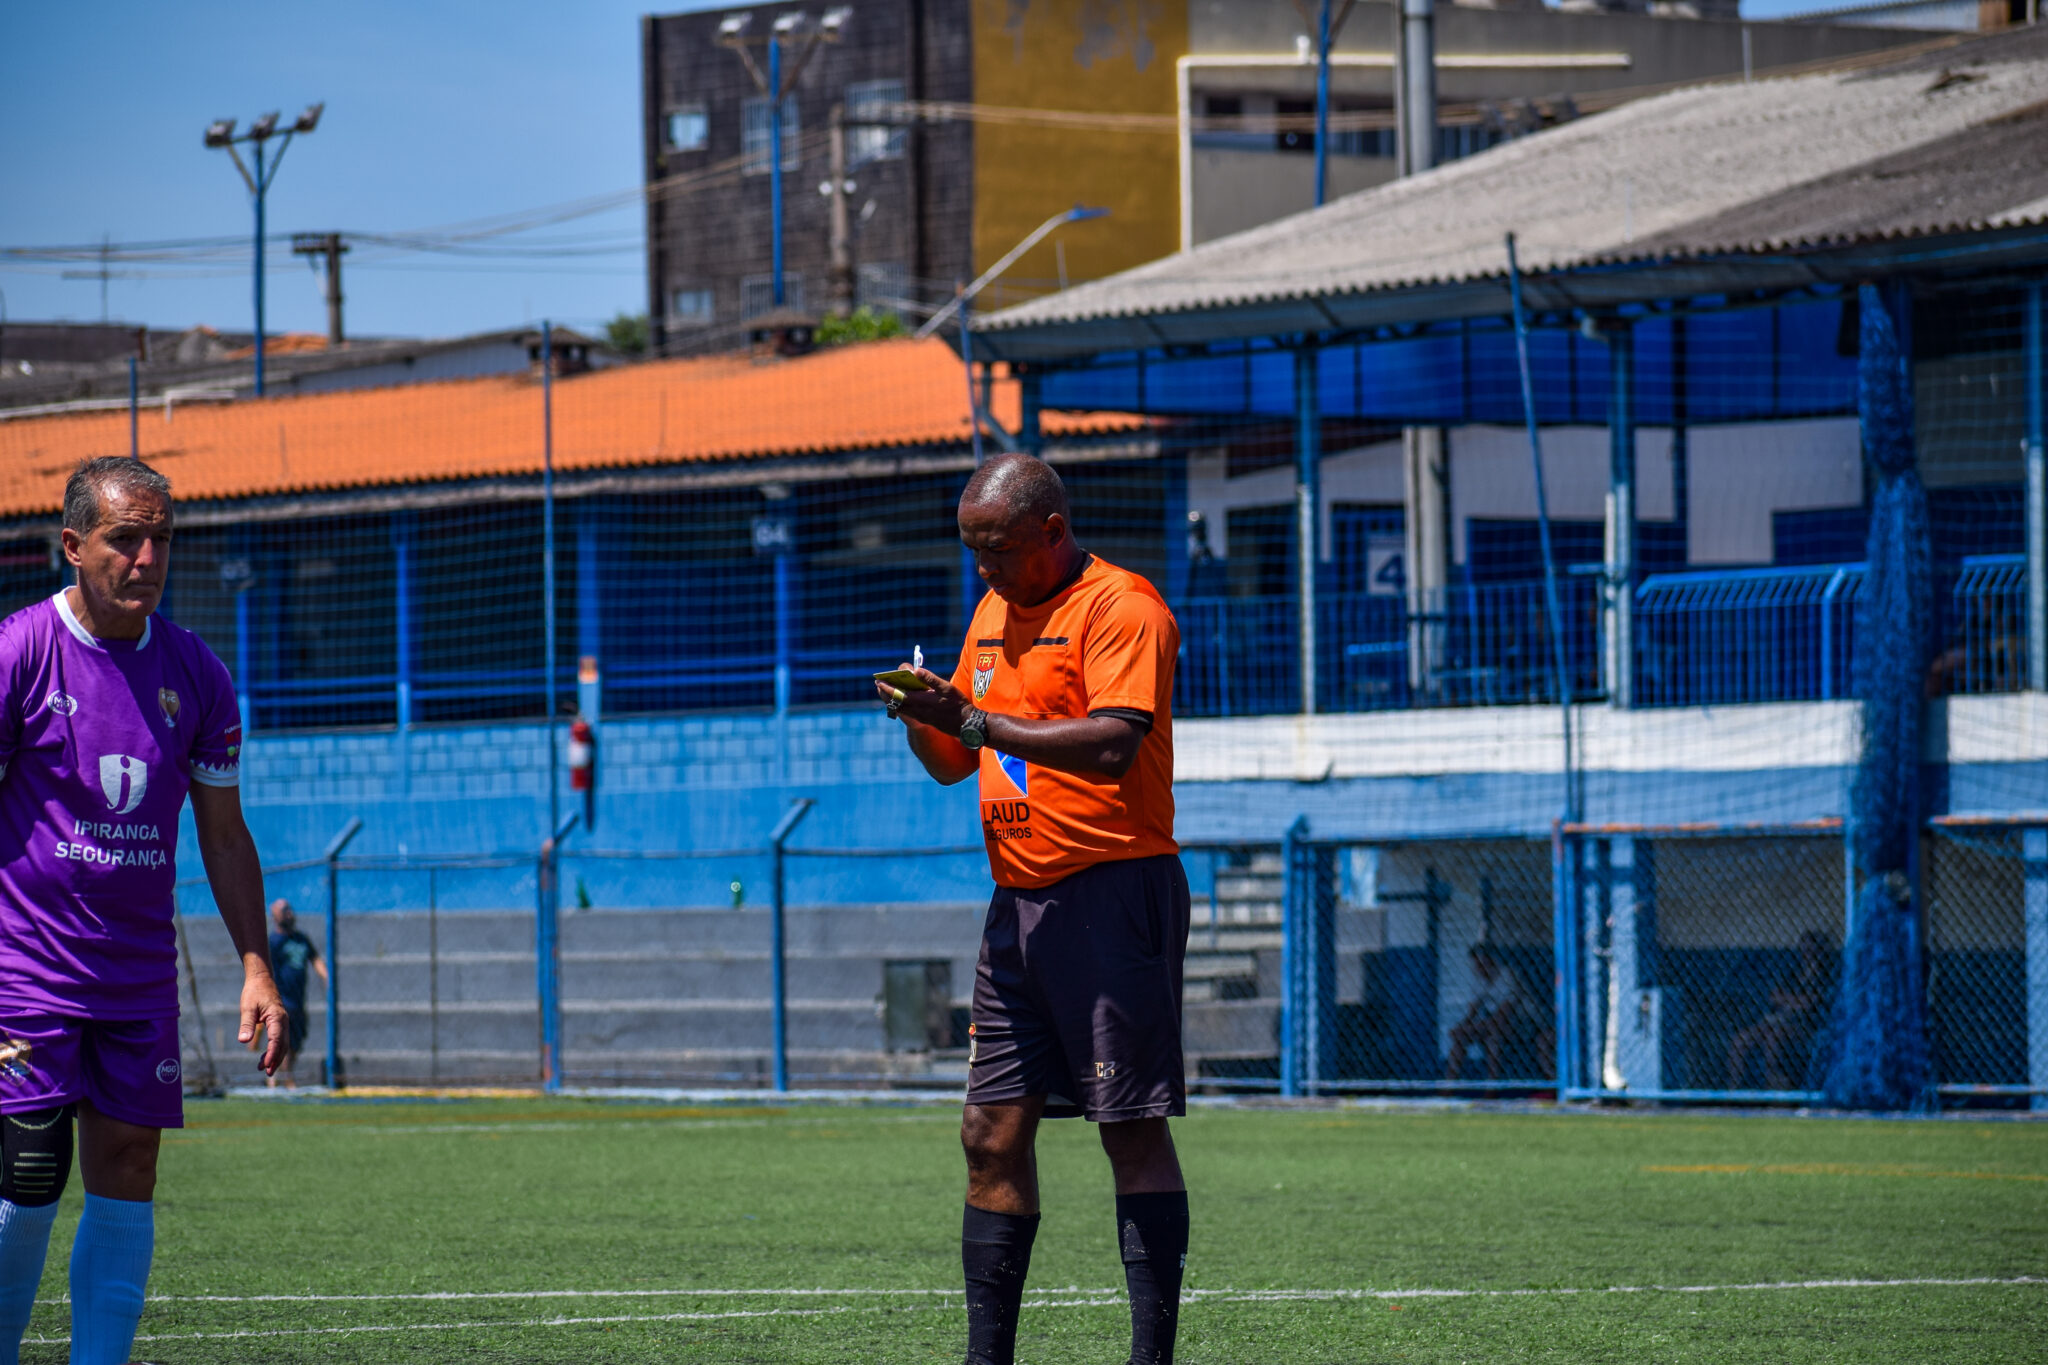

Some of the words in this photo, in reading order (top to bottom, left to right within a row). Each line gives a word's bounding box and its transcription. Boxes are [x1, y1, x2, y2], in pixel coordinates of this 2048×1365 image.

[1375, 554, 1406, 593] 4
[982, 801, 1031, 825] LAUD
[74, 819, 160, 840] IPIRANGA
[54, 840, 167, 871] SEGURANÇA
